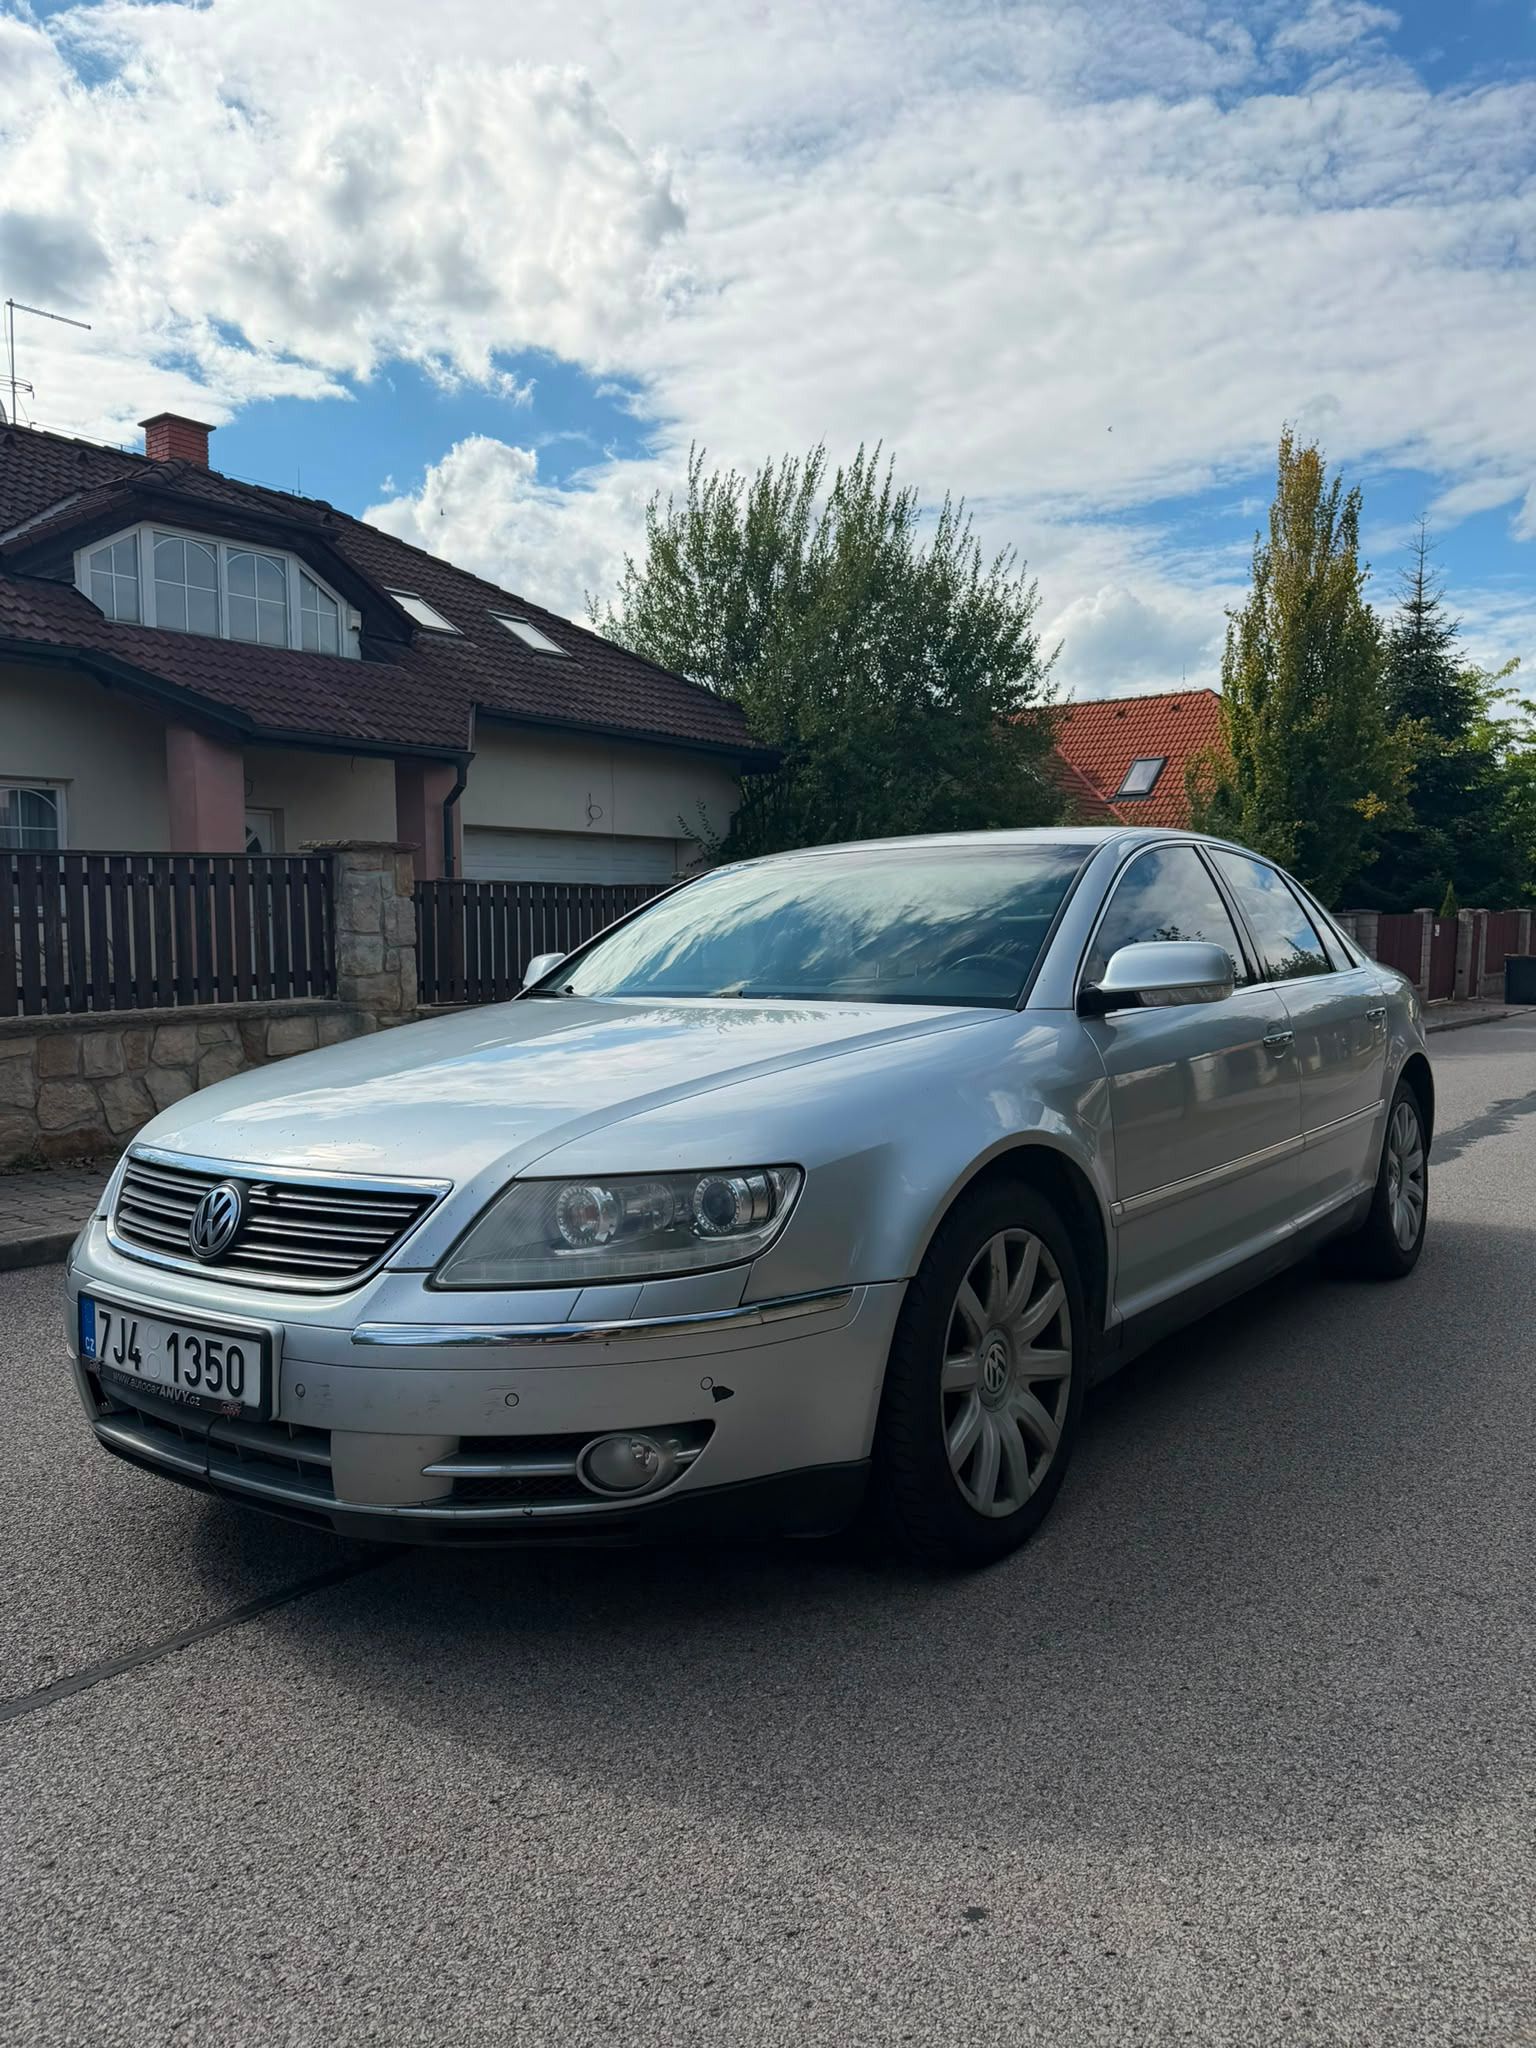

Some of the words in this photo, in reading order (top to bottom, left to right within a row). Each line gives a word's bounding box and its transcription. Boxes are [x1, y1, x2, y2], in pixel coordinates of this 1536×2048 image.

[191, 1185, 239, 1256] VW
[85, 1336, 95, 1352] CZ
[99, 1310, 142, 1371] 7J4
[166, 1332, 244, 1396] 1350
